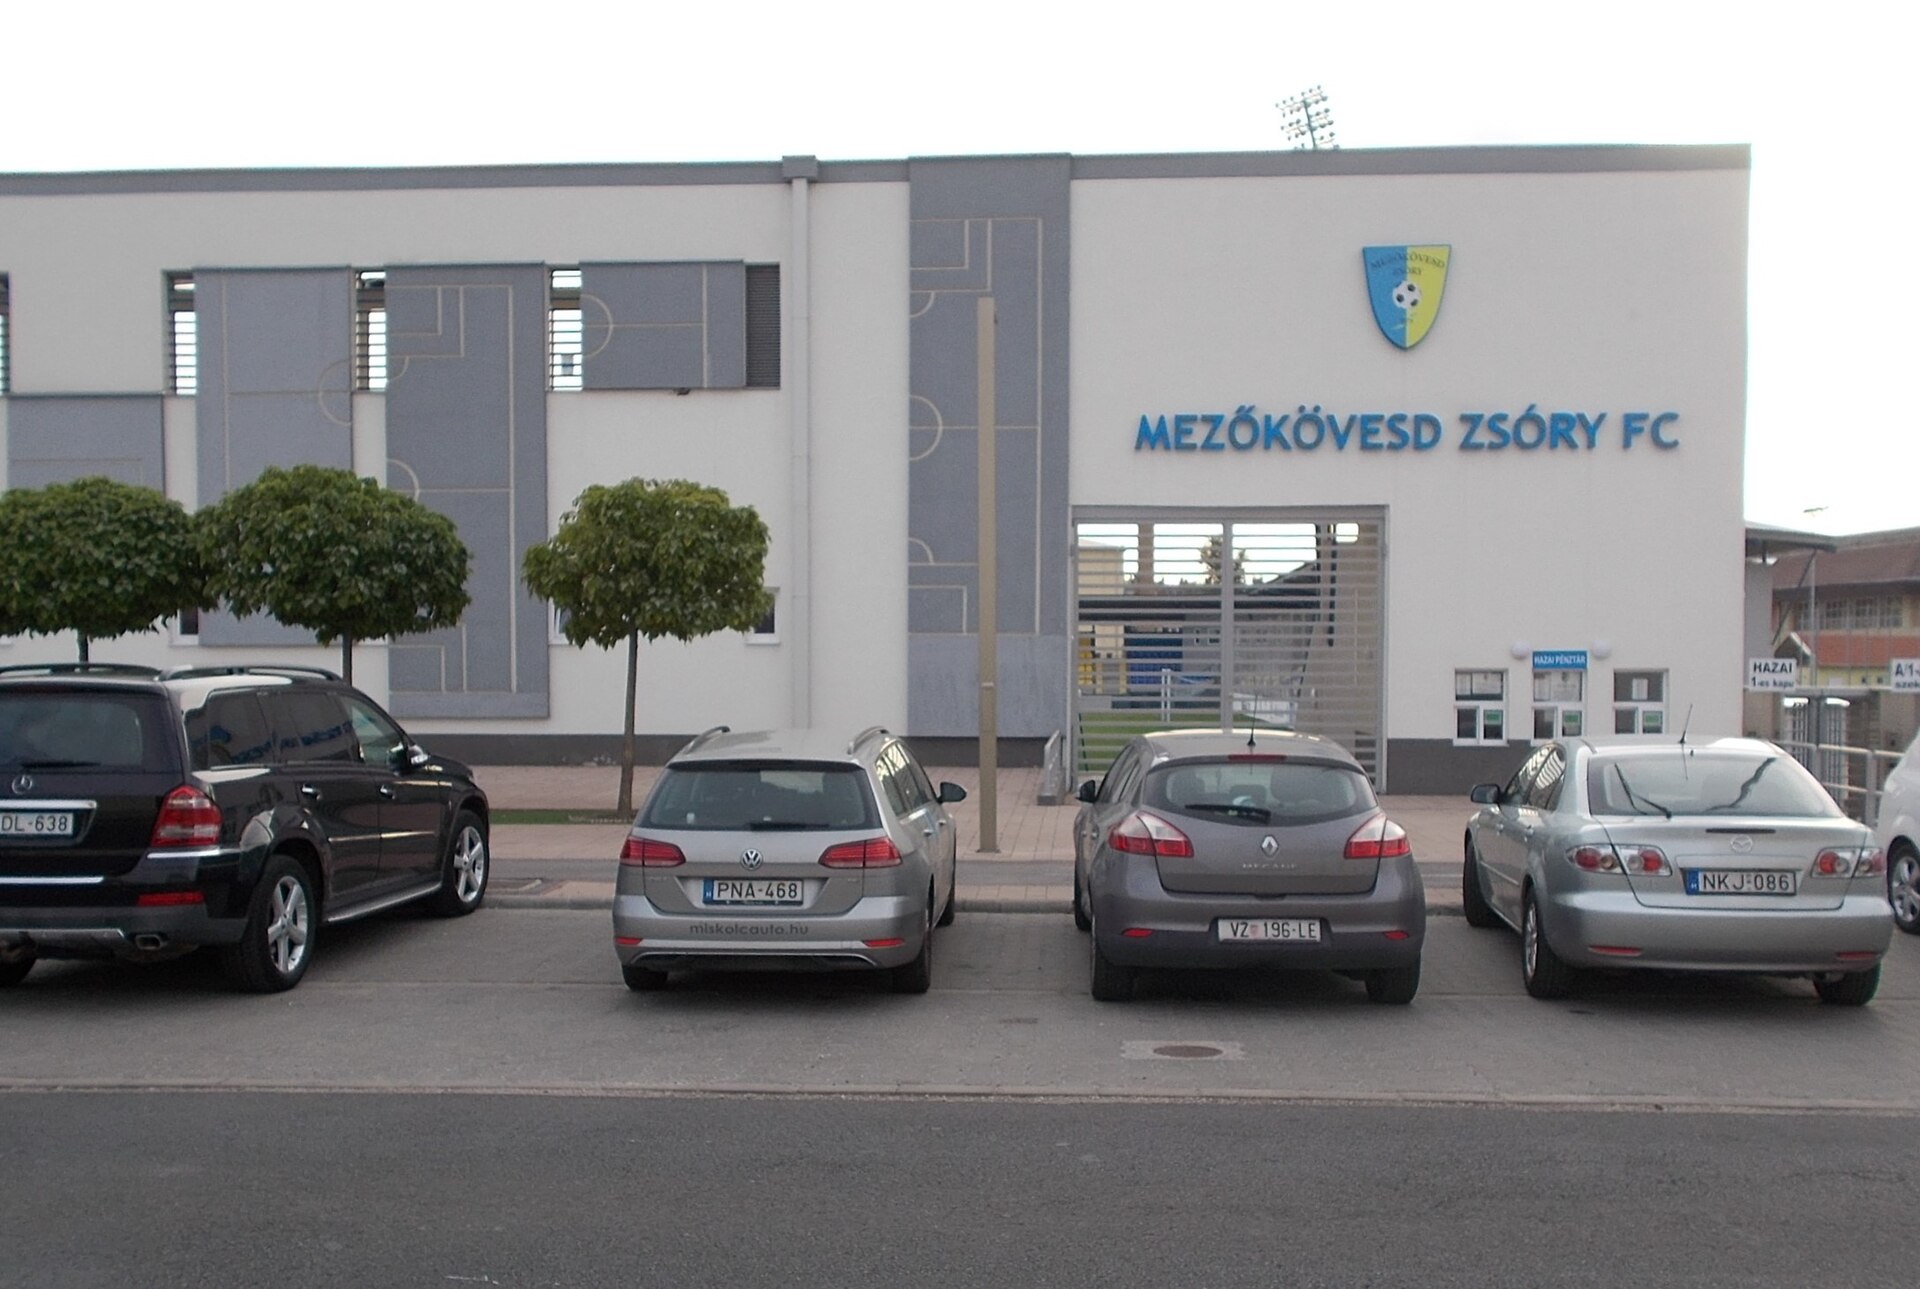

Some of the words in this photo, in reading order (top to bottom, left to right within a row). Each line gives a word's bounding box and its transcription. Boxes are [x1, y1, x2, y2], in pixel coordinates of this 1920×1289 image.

[1135, 405, 1442, 450] MEZŐKÖVESD
[1458, 404, 1607, 450] ZSÓRY
[1622, 412, 1679, 450] FC
[1534, 655, 1554, 664] HAZAI
[1753, 662, 1792, 672] HAZAI
[717, 882, 798, 898] PNA-468
[1703, 873, 1790, 891] NKJ-086
[1230, 922, 1249, 938] VZ
